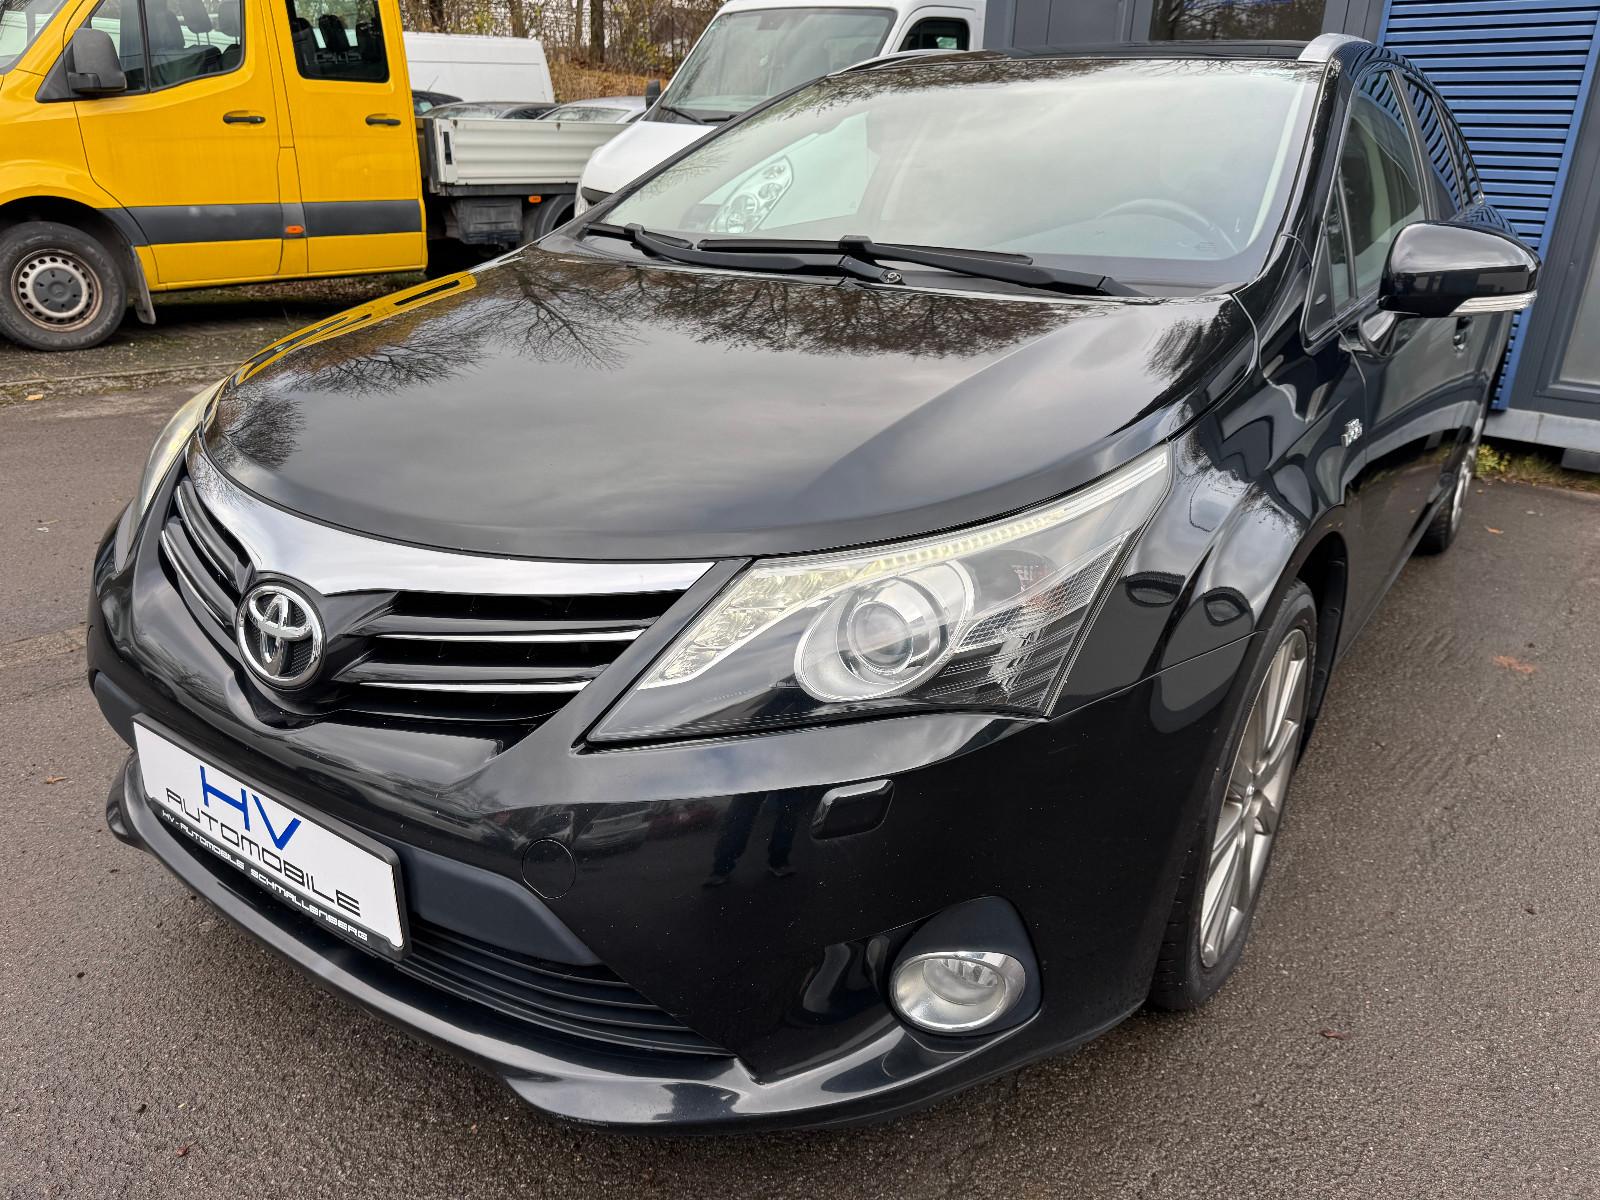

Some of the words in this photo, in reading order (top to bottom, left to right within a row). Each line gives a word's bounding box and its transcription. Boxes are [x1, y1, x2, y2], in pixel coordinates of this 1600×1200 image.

[200, 765, 301, 850] HV
[165, 787, 361, 918] AUTOMOBILE
[250, 868, 368, 942] SCHMALLENBERG
